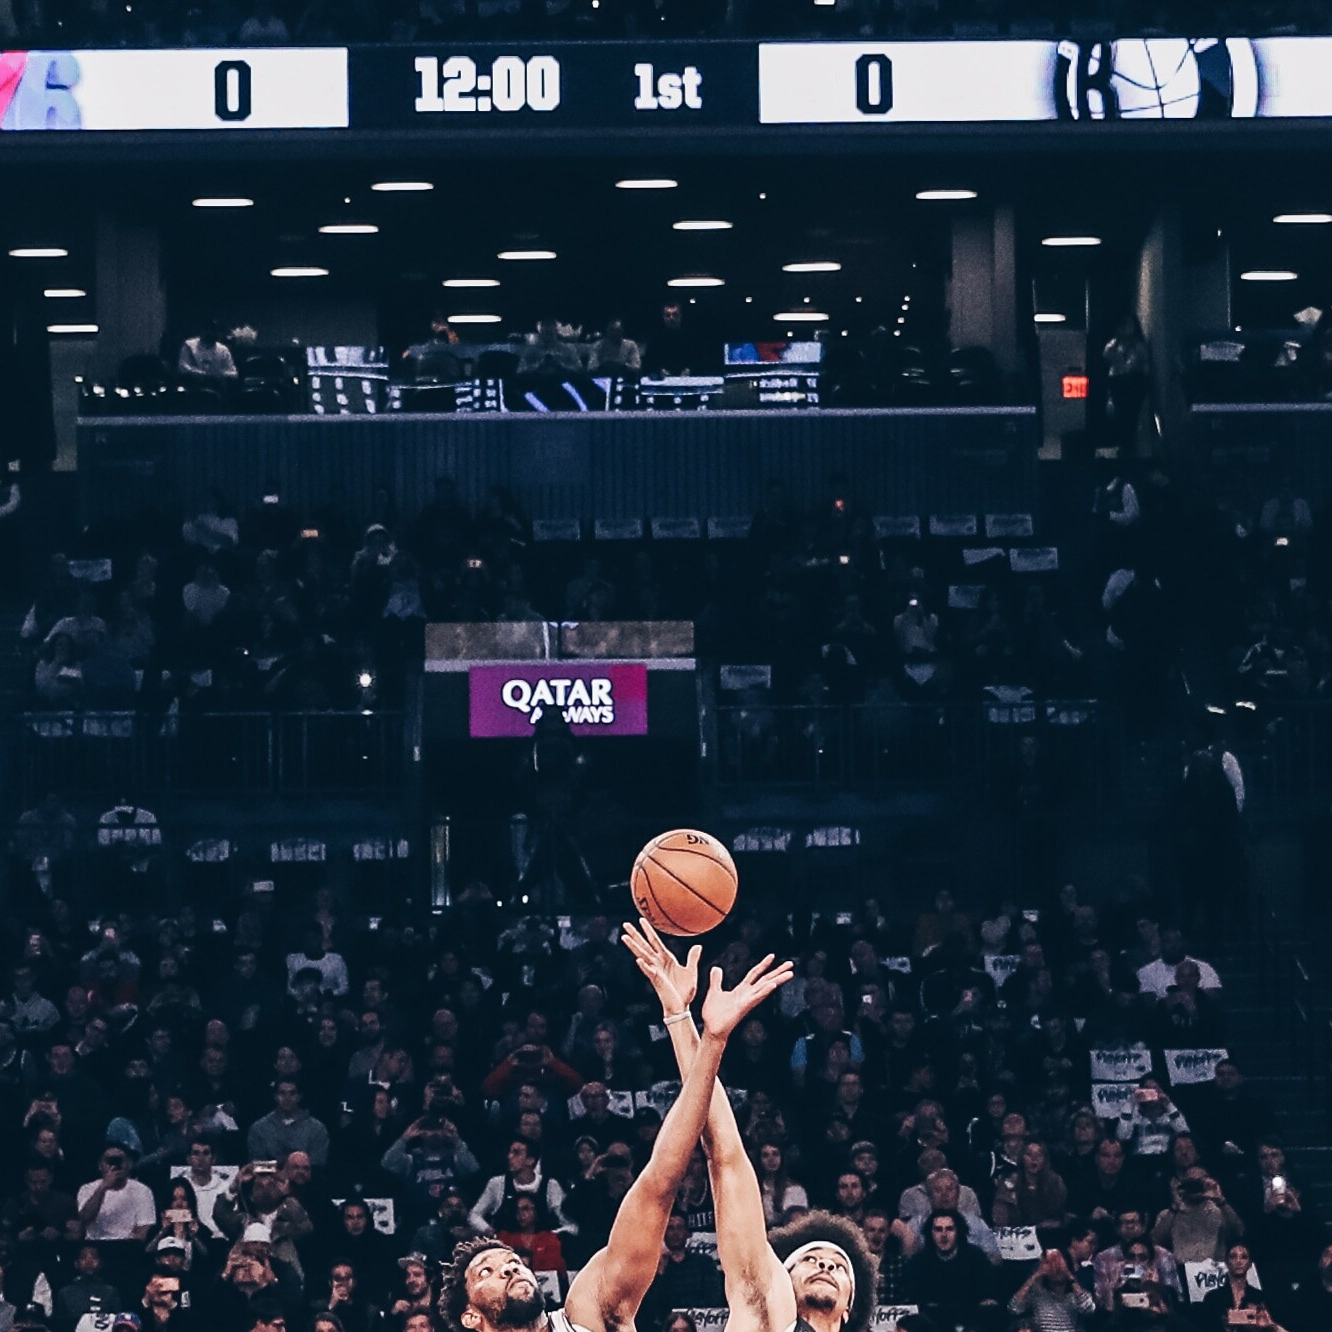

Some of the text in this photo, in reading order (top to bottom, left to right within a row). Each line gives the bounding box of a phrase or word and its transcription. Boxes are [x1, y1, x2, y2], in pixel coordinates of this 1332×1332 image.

[215, 60, 251, 121] 0
[415, 56, 560, 112] 12:00
[634, 63, 702, 110] 1st
[855, 53, 893, 114] 0
[502, 679, 613, 712] QATAR
[529, 706, 615, 724] AWAYS
